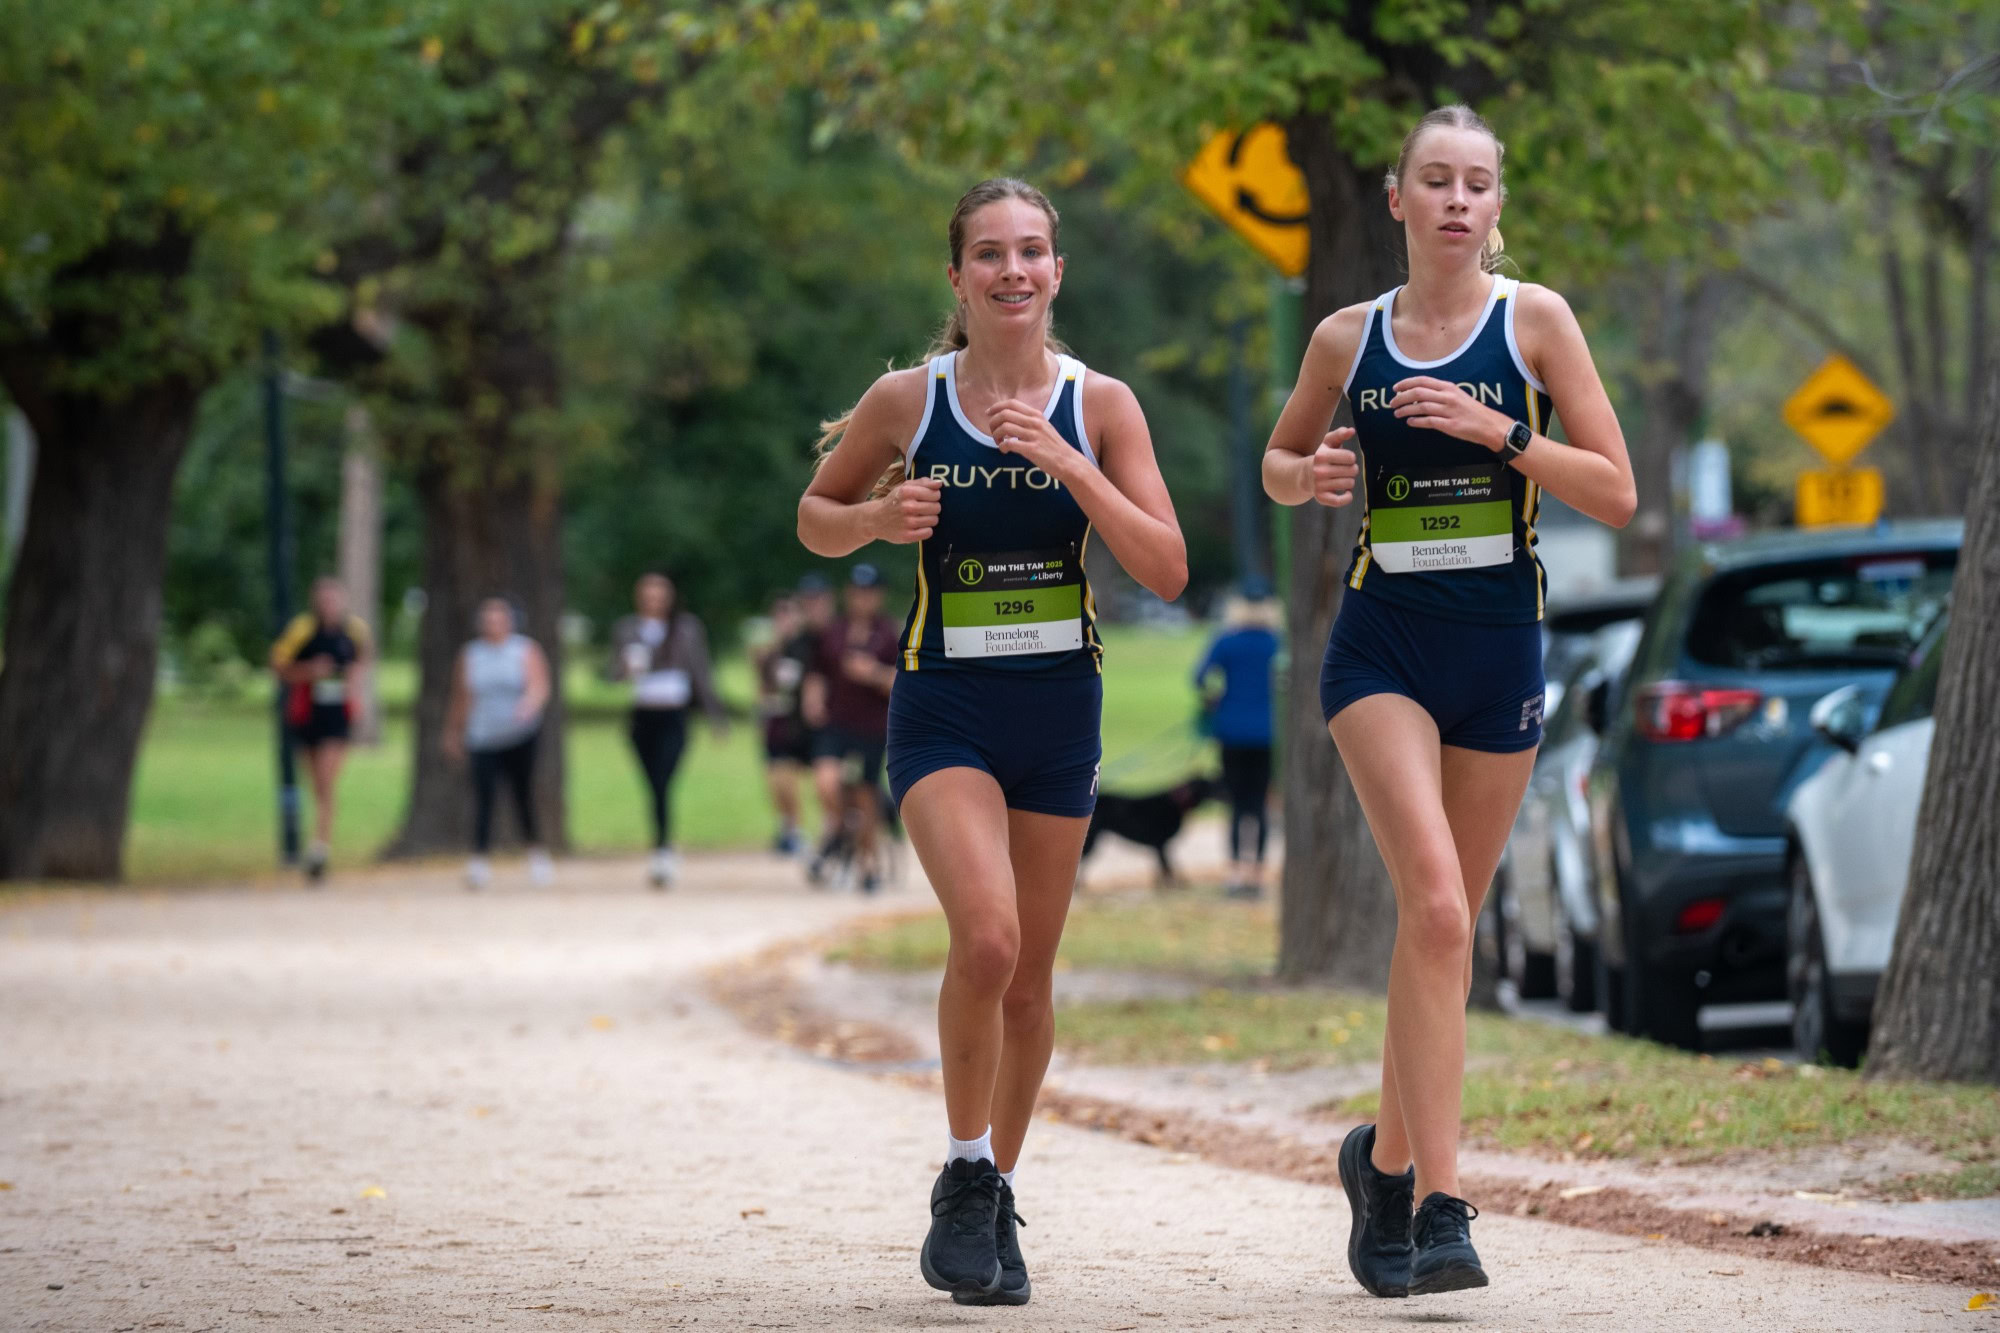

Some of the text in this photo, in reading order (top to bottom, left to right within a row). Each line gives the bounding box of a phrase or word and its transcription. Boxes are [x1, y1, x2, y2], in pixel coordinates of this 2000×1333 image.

[1360, 382, 1503, 412] RUON
[1413, 476, 1491, 488] RUN THE TAN 2025
[1463, 487, 1492, 496] Liberty
[1420, 515, 1461, 531] 1292
[1412, 543, 1467, 556] Bennelong
[988, 560, 1063, 573] RUN THE TAN 2025
[1412, 554, 1475, 568] Foundation.
[1038, 571, 1063, 580] Liberty
[993, 599, 1035, 616] 1296
[985, 628, 1040, 641] Bennelong
[985, 640, 1047, 653] Foundation.
